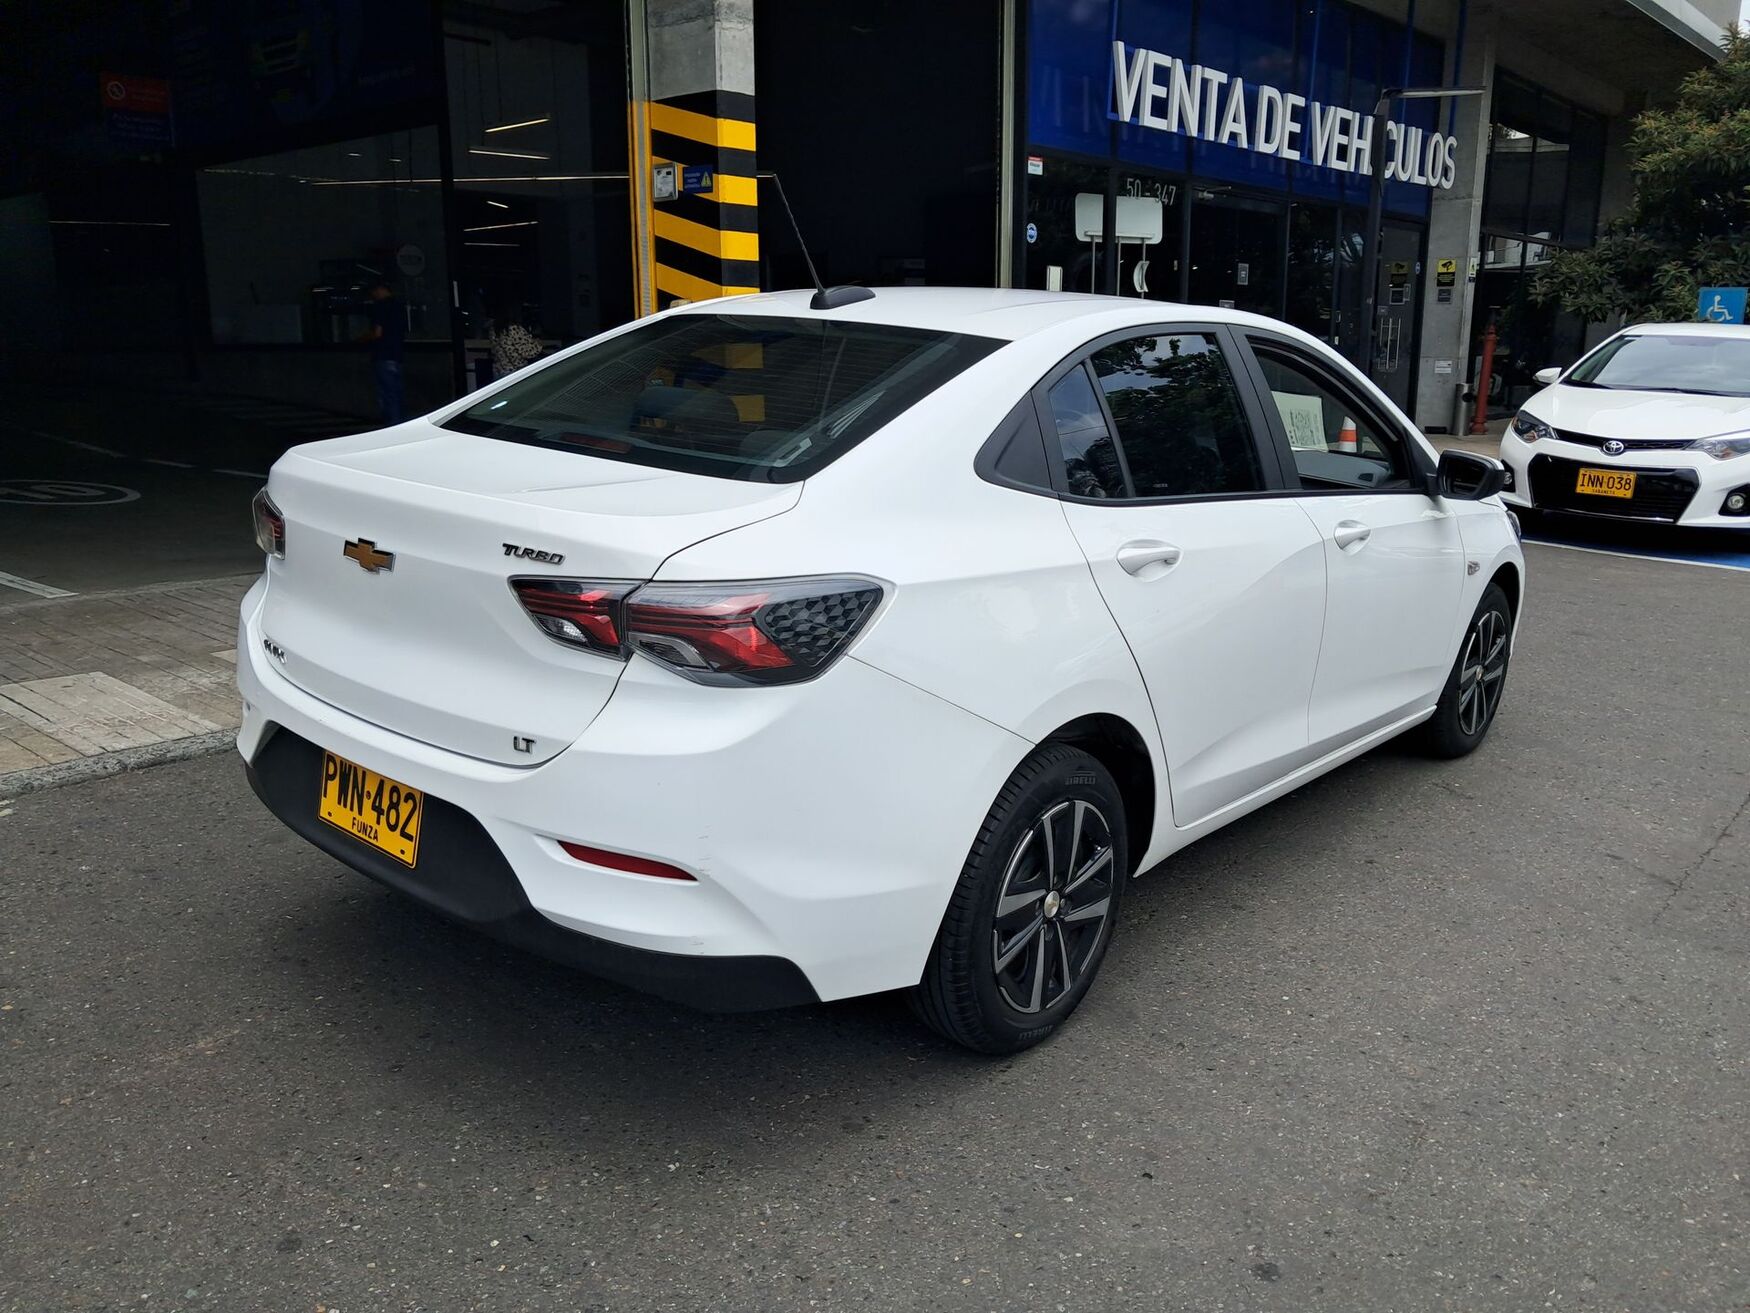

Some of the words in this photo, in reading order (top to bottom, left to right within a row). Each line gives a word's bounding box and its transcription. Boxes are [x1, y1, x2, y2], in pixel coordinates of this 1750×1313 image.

[1112, 40, 1249, 149] VENTA
[1254, 84, 1305, 161] DE
[1311, 101, 1458, 190] VEHCULOS
[1126, 178, 1142, 199] 50
[1154, 182, 1177, 206] 347
[502, 542, 566, 566] TURBO
[513, 735, 536, 755] LT
[351, 816, 379, 843] FUNZA
